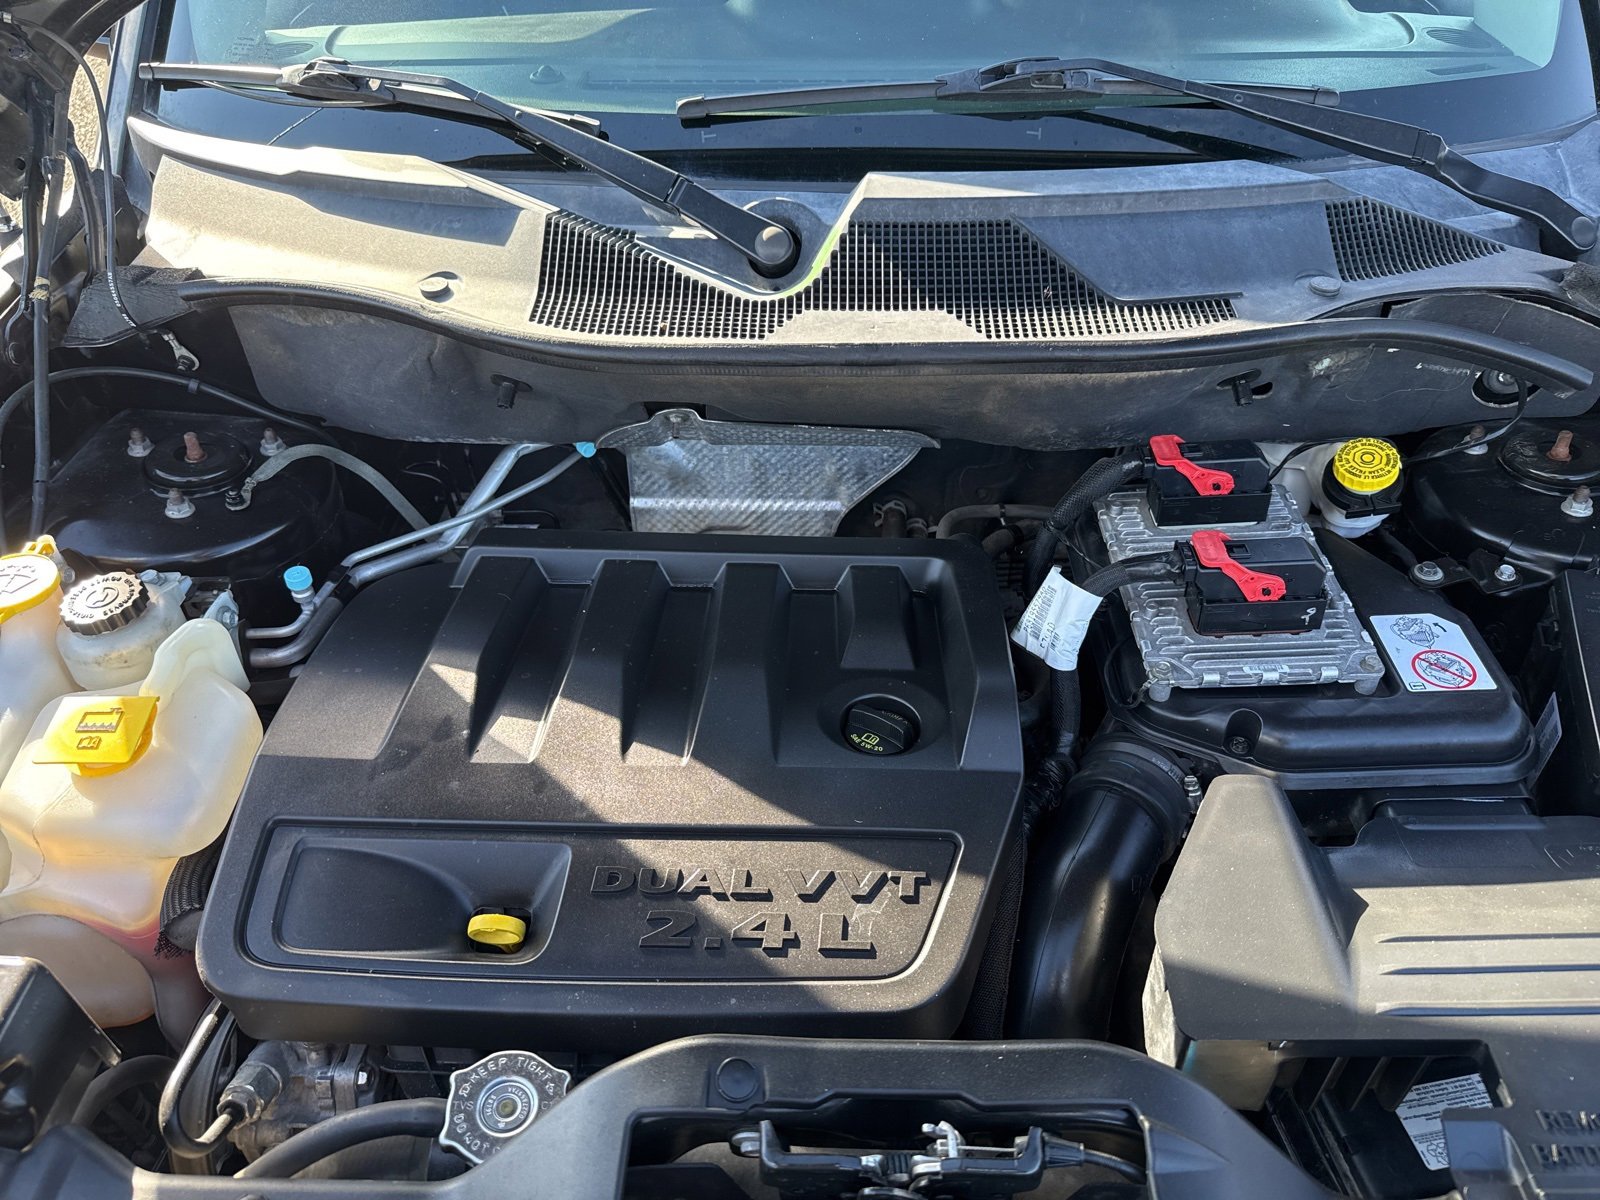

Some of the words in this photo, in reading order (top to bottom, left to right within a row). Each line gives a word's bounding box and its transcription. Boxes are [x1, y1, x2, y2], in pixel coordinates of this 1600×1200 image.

[860, 742, 883, 752] 5W-20
[590, 865, 773, 900] DUAL
[784, 868, 931, 903] VVT
[470, 1057, 507, 1084] KEEP
[517, 1056, 553, 1081] TIGHT
[453, 1100, 474, 1110] TVS
